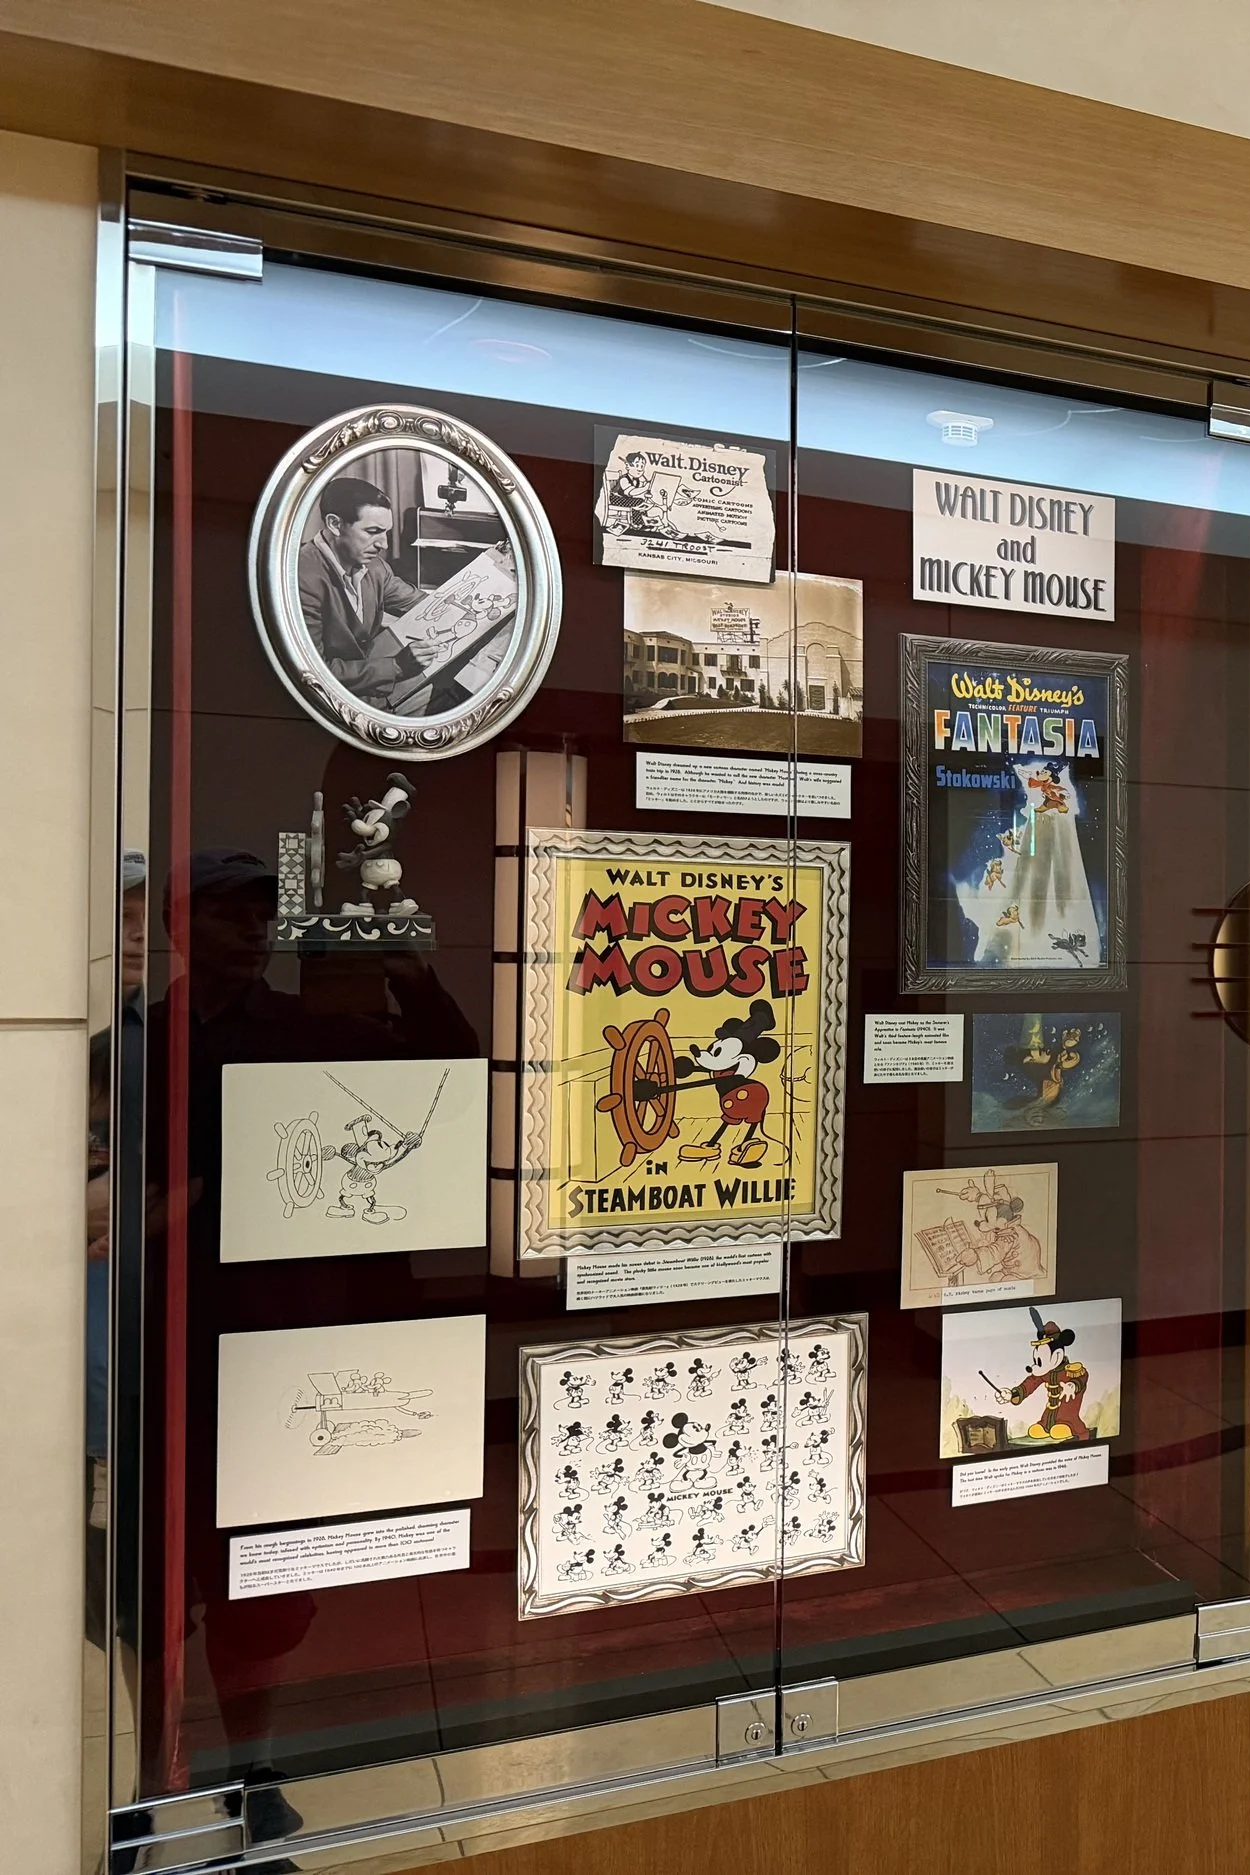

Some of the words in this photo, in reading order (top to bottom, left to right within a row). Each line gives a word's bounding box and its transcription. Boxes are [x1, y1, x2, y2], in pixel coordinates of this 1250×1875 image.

[689, 457, 750, 480] Disney
[692, 472, 748, 487] Cartoonist
[718, 500, 754, 508] CARTOONS
[724, 506, 752, 515] CARTOONS
[935, 481, 1003, 524] WALT
[1010, 492, 1094, 536] DISNEY
[720, 519, 748, 527] CARTOONS
[996, 535, 1036, 564] and
[920, 557, 1016, 600] MICKEY
[1024, 570, 1107, 612] MOUSE
[951, 672, 1004, 700] Walt
[1007, 676, 1084, 707] Disney's
[968, 703, 1006, 712] TECHNICOLOR
[1008, 704, 1038, 712] FEATURE
[934, 709, 1100, 758] FANTASIA
[936, 764, 1016, 788] Stokowski
[606, 868, 670, 886] WALT
[681, 872, 784, 892] DISNEY'S
[572, 888, 808, 944] MICKEY
[567, 941, 810, 999] MOUSE
[568, 1184, 706, 1218] STEAMBOAT
[714, 1178, 796, 1208] WILLIE
[666, 1492, 700, 1501] MICKEY
[703, 1488, 733, 1497] MOUSE
